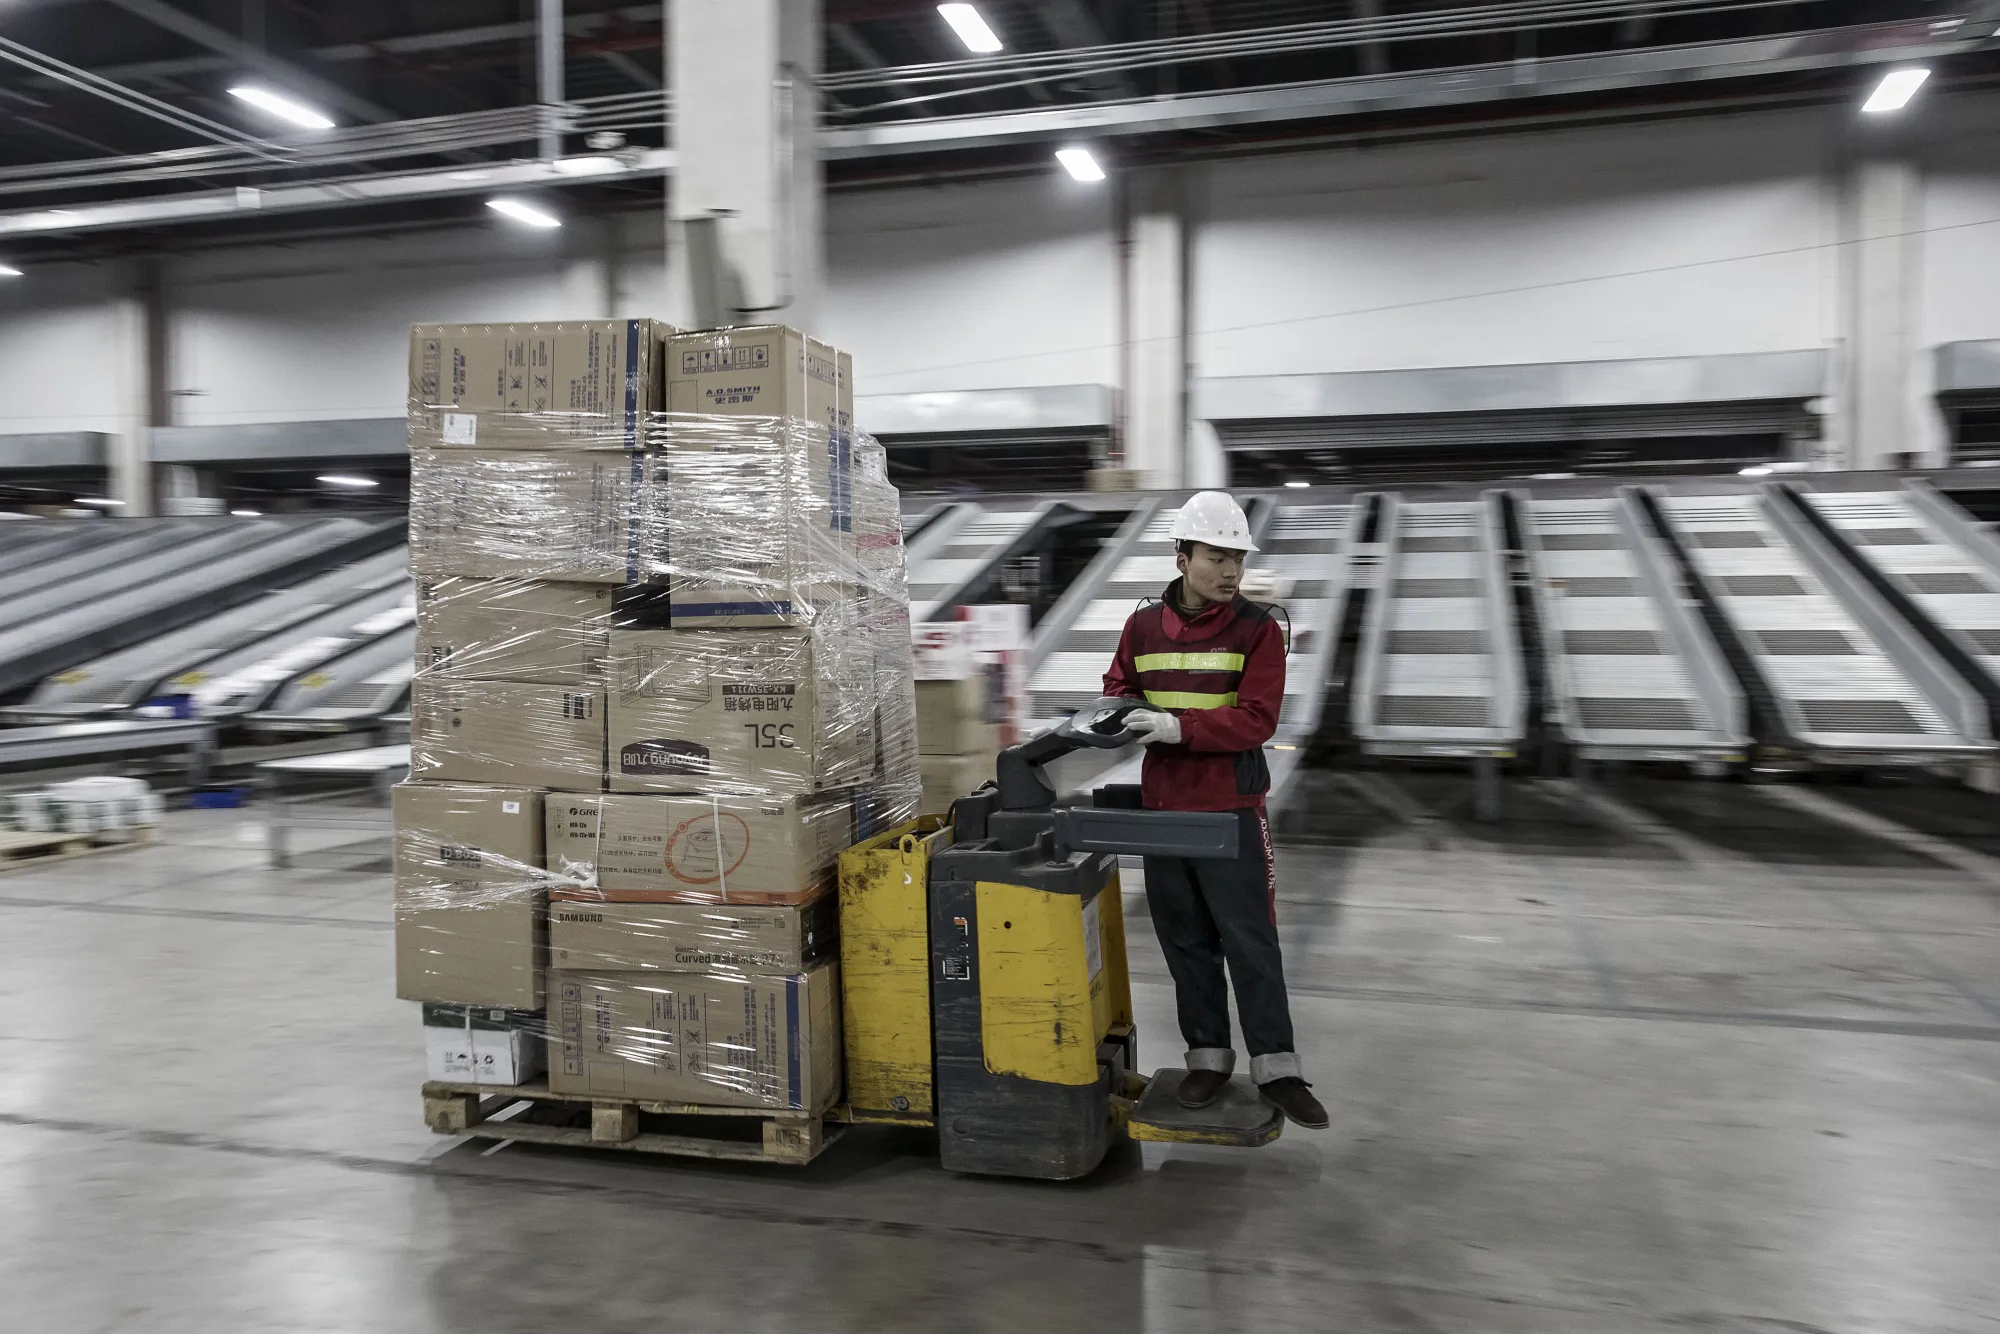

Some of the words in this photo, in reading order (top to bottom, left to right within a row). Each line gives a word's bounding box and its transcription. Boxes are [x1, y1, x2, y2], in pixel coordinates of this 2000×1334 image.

[706, 385, 761, 396] A.O.SMITH
[715, 395, 754, 405] 史密斯
[724, 697, 793, 712] 九阳电烤箱
[744, 723, 795, 749] 35L
[558, 913, 603, 923] SAMSUNG
